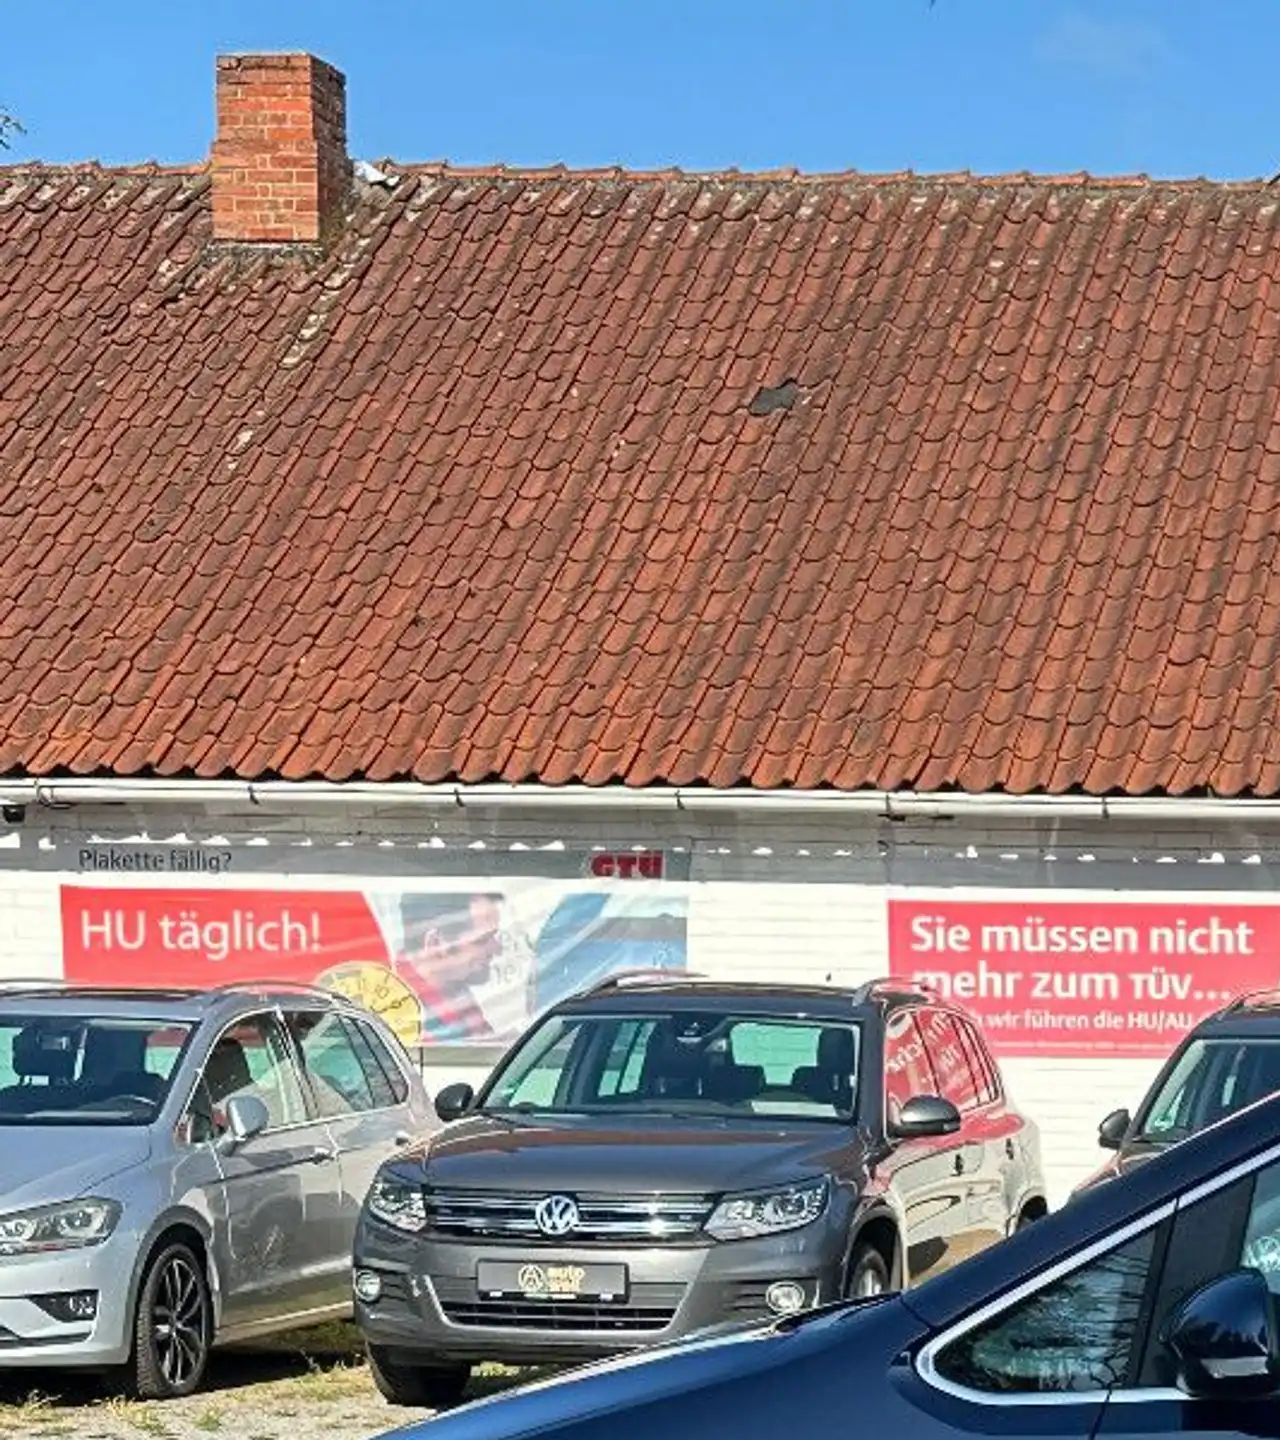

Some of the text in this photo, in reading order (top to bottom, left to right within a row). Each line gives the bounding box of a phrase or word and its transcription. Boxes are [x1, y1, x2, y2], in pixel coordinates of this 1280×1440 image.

[79, 849, 232, 873] Plakette fällig?
[80, 909, 321, 961] HU täglich!
[910, 915, 1255, 955] Sie müssen nicht
[912, 961, 1023, 998] mehr
[1031, 972, 1118, 999] zum
[985, 1009, 1020, 1029] wir
[1024, 1008, 1090, 1029] führen
[1093, 1009, 1125, 1029] die
[1128, 1010, 1192, 1034] HU/AU
